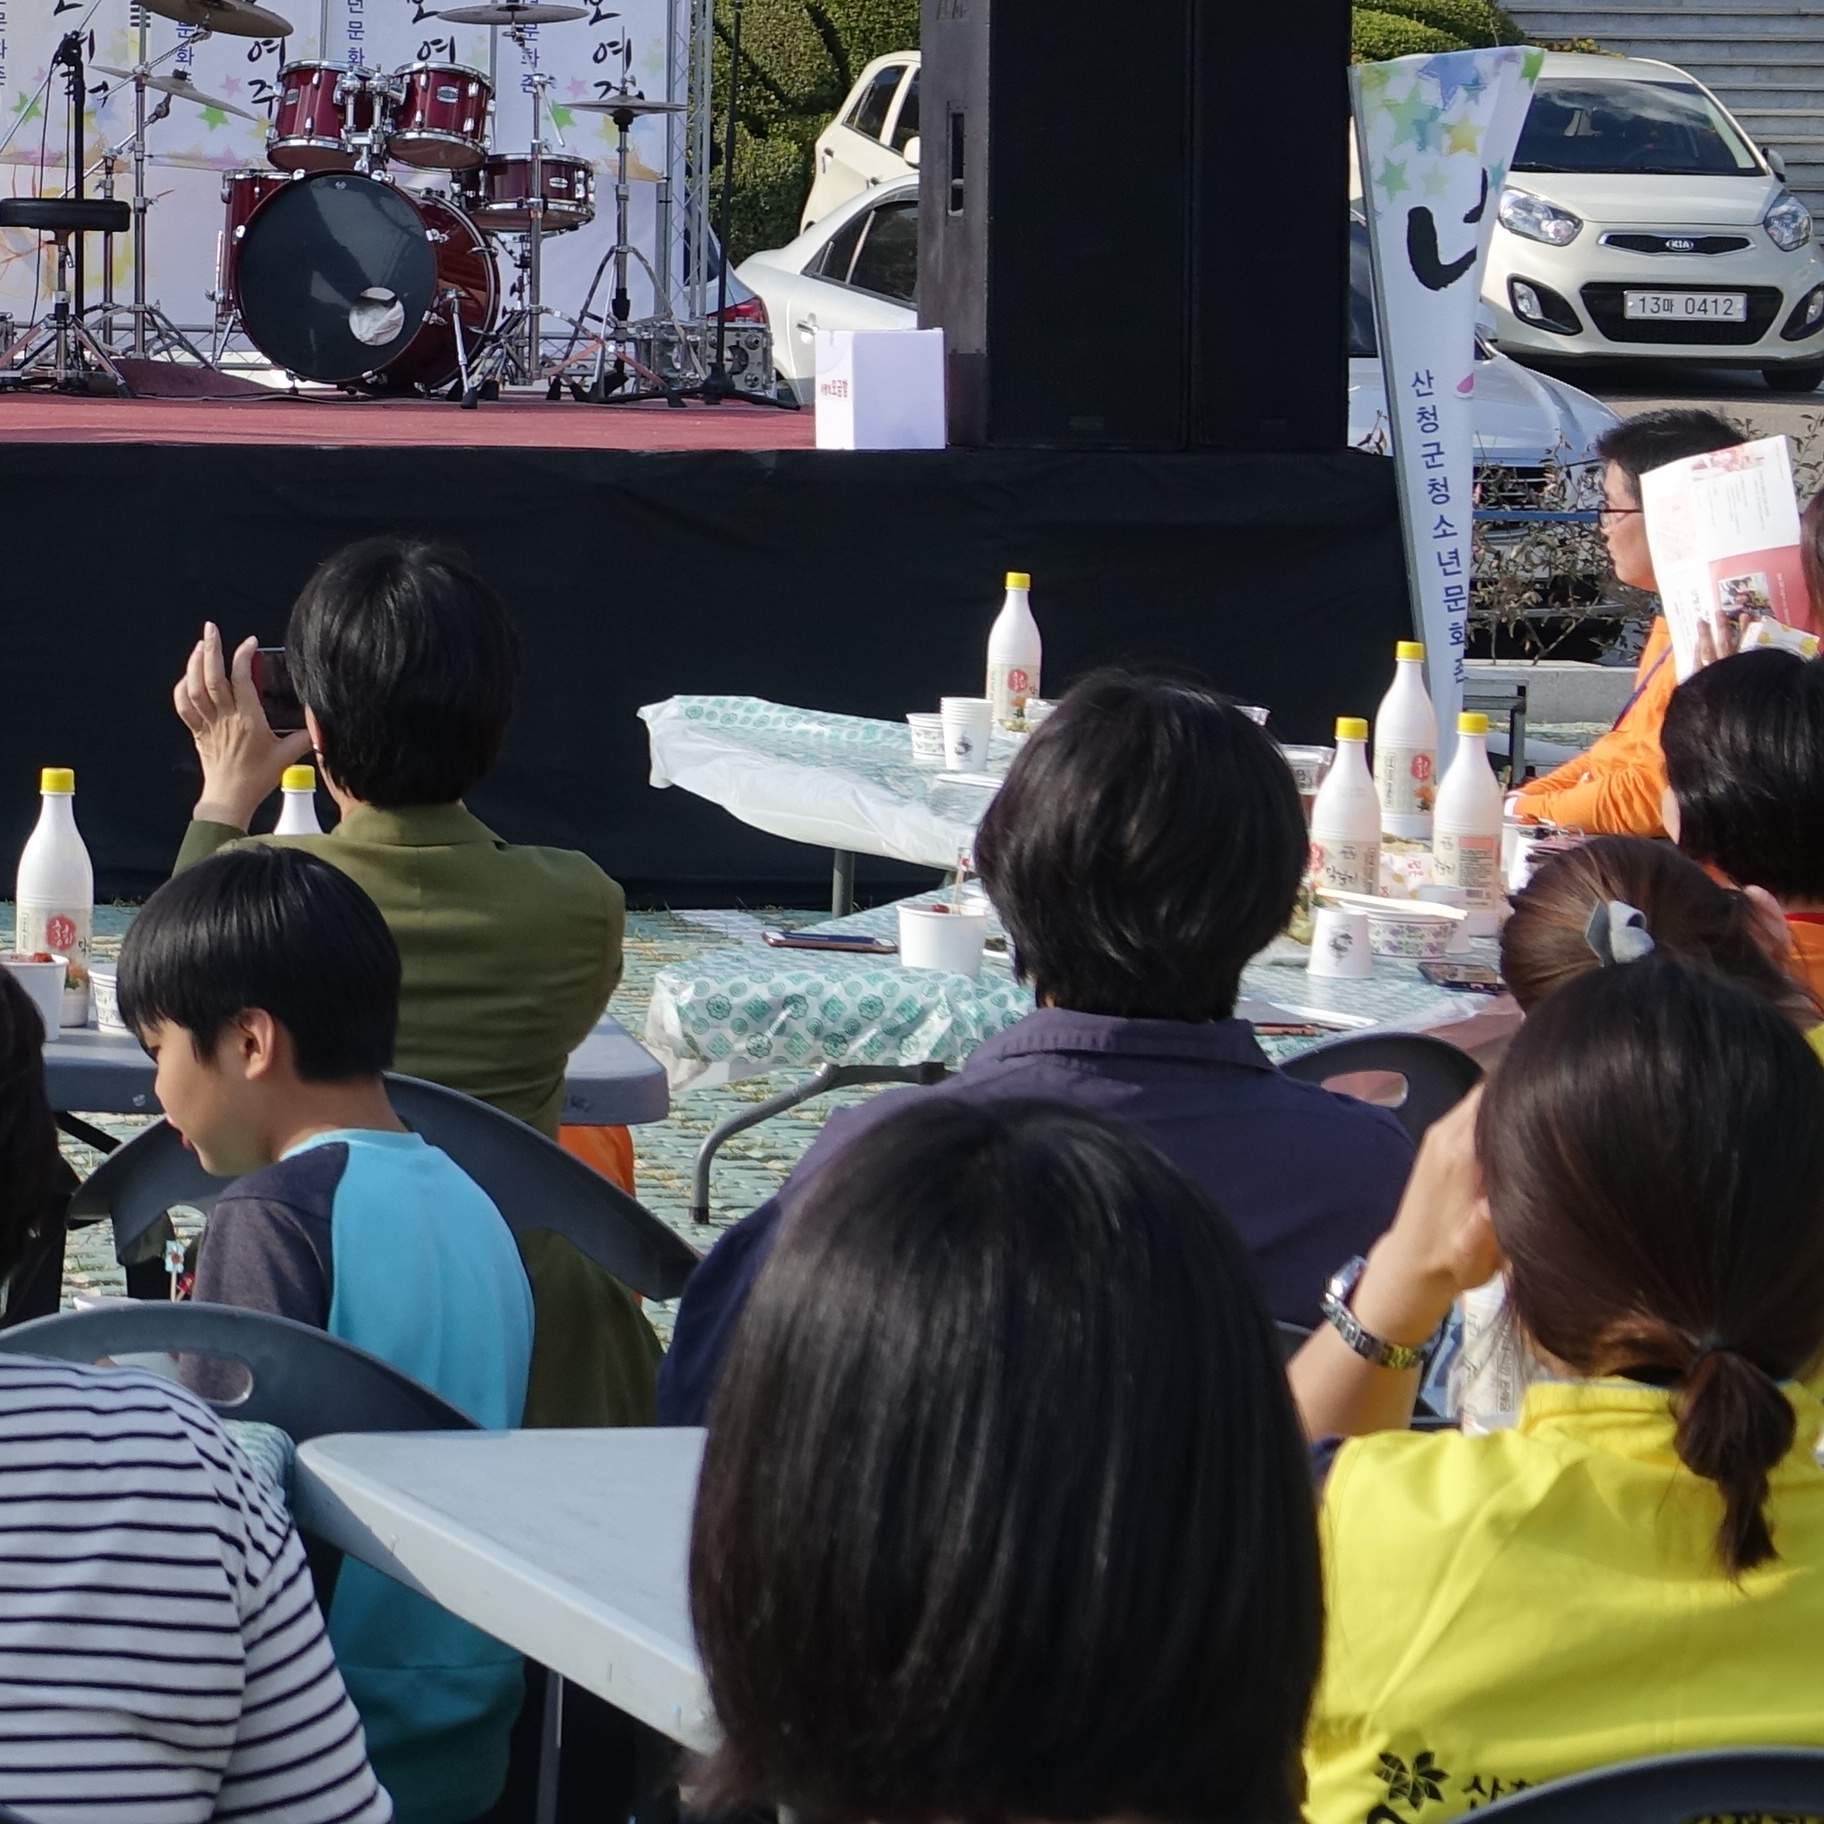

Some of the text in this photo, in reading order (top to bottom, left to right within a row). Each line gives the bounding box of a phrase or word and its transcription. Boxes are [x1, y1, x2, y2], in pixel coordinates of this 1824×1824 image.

[1669, 239, 1691, 250] KIA
[1638, 295, 1734, 316] 13마 0412
